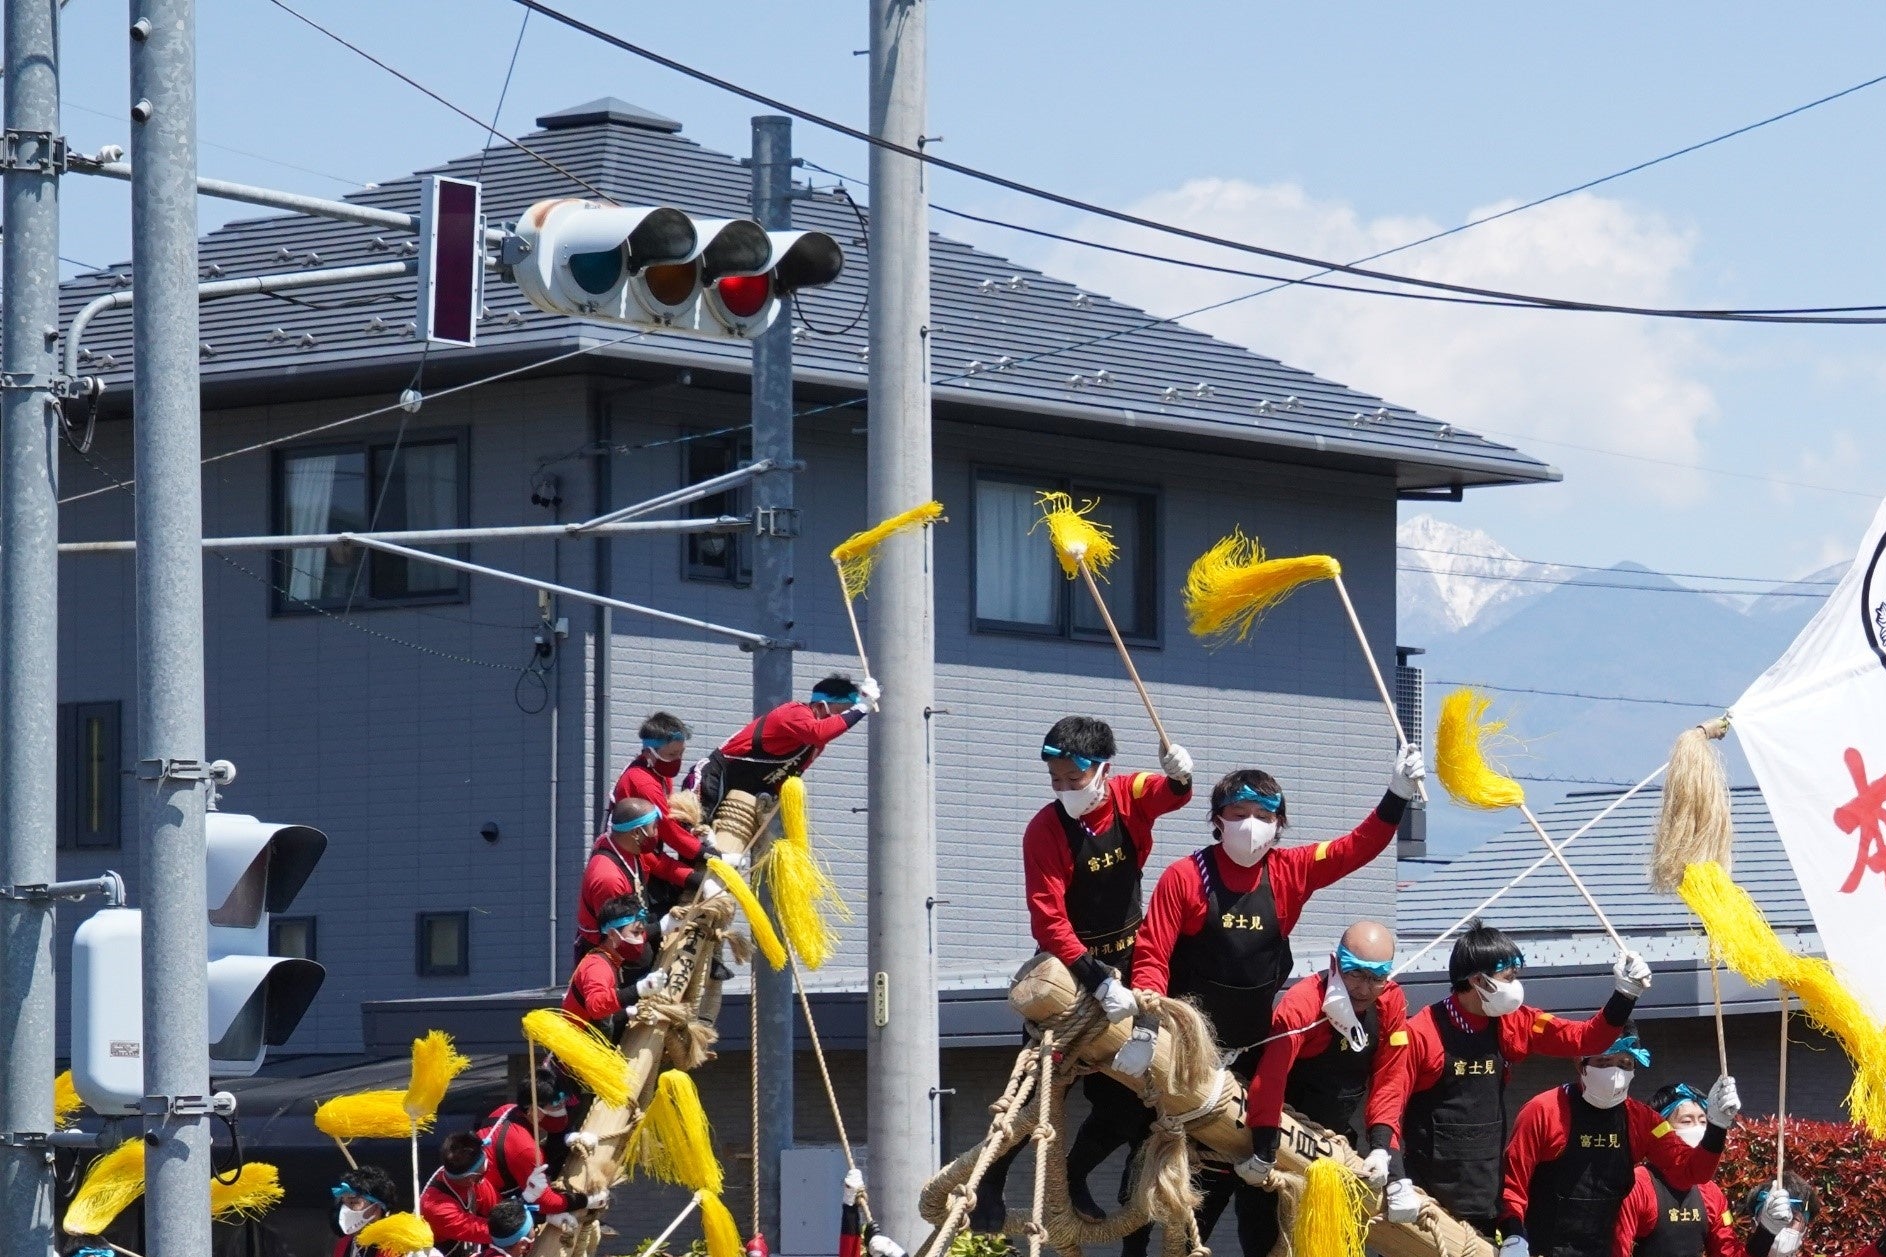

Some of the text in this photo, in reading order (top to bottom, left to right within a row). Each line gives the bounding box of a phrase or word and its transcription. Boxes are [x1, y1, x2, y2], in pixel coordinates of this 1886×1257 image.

[1087, 846, 1127, 873] 富士見
[1221, 912, 1264, 932] 富士見
[1453, 1059, 1496, 1076] 富士見
[1579, 1133, 1622, 1150] 富士見
[1668, 1207, 1701, 1224] 富士見
